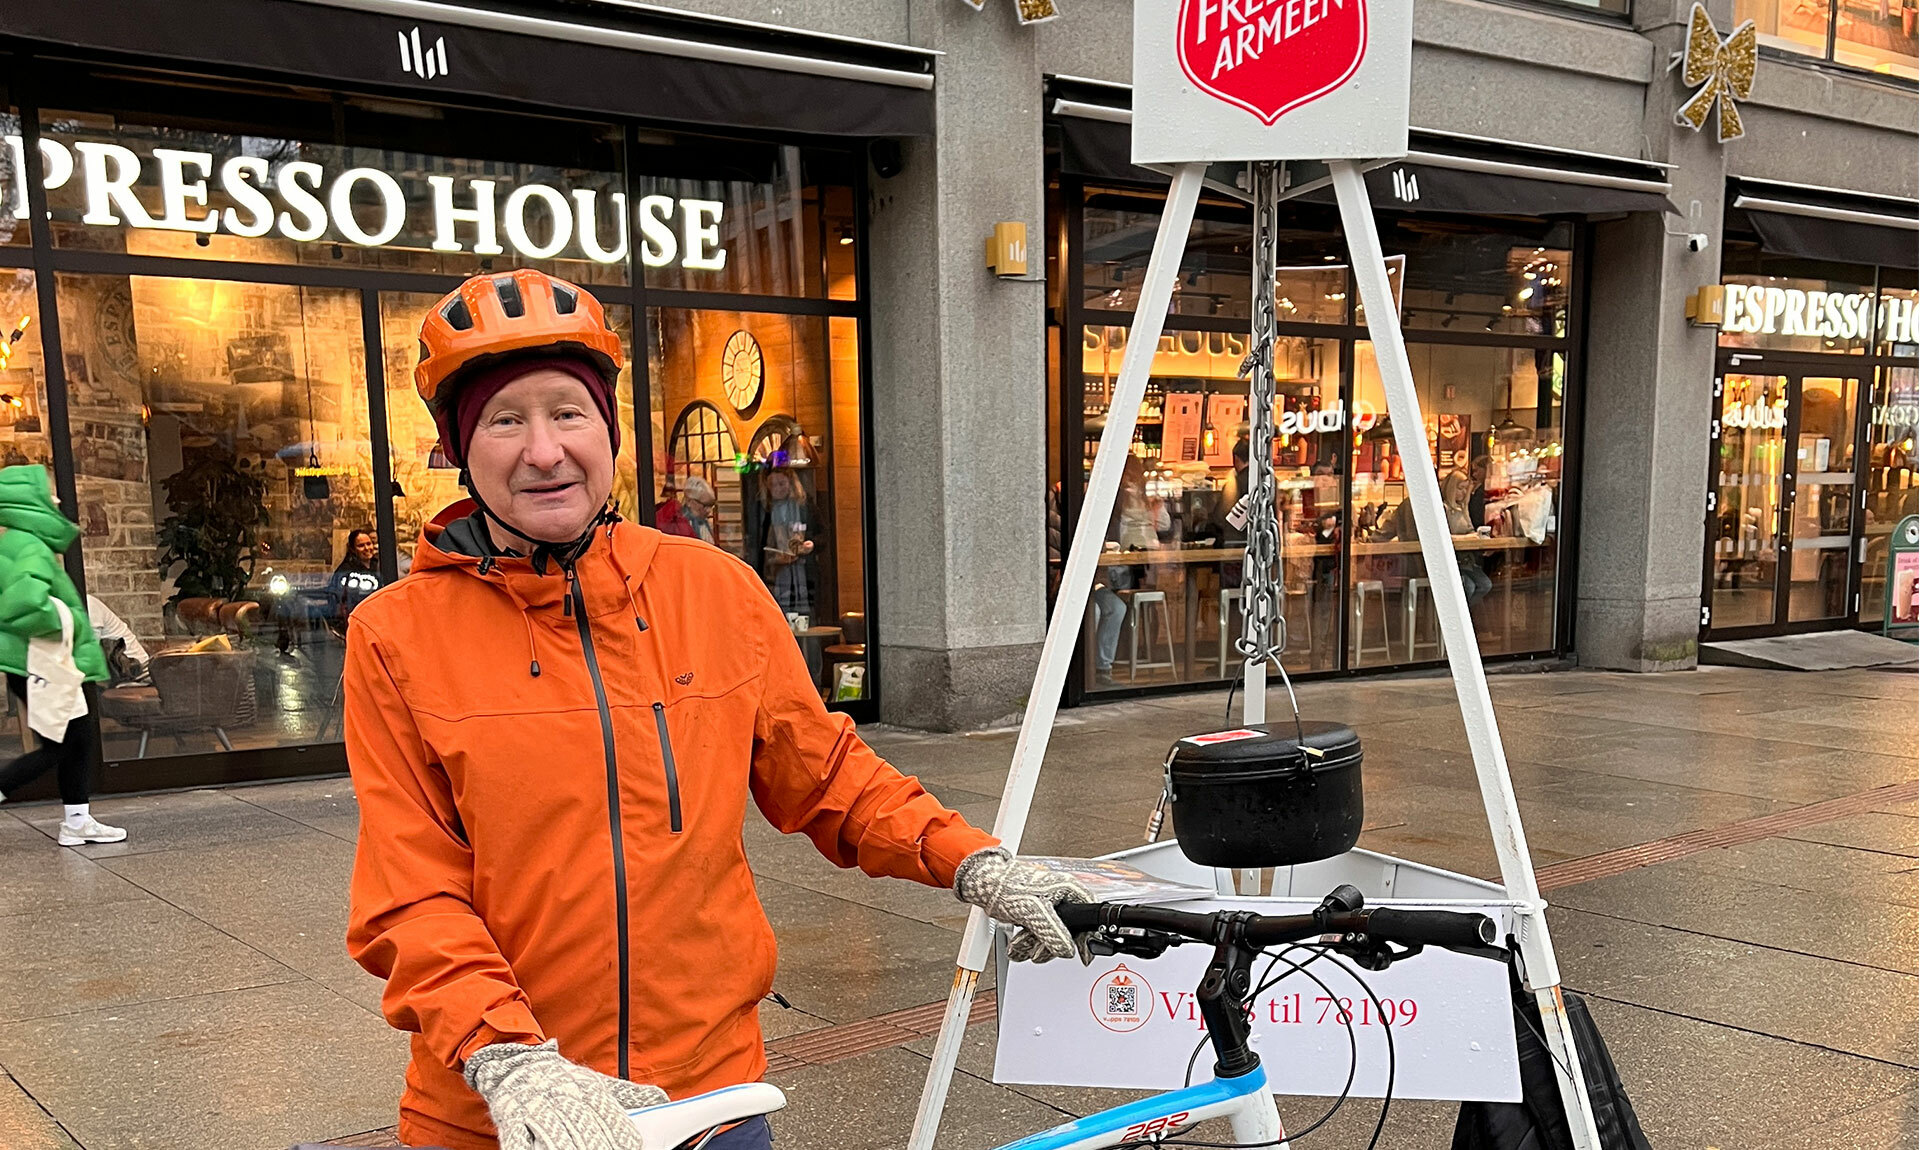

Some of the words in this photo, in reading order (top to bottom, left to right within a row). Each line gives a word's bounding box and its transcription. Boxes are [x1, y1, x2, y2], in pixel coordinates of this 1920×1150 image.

[1210, 0, 1344, 81] ARMEEN
[0, 135, 408, 247] PRESSO
[427, 175, 727, 271] HOUSE
[1722, 283, 1885, 340] ESPRESSO
[1159, 991, 1256, 1031] Vis
[1268, 992, 1303, 1024] til
[1314, 996, 1418, 1027] 78109
